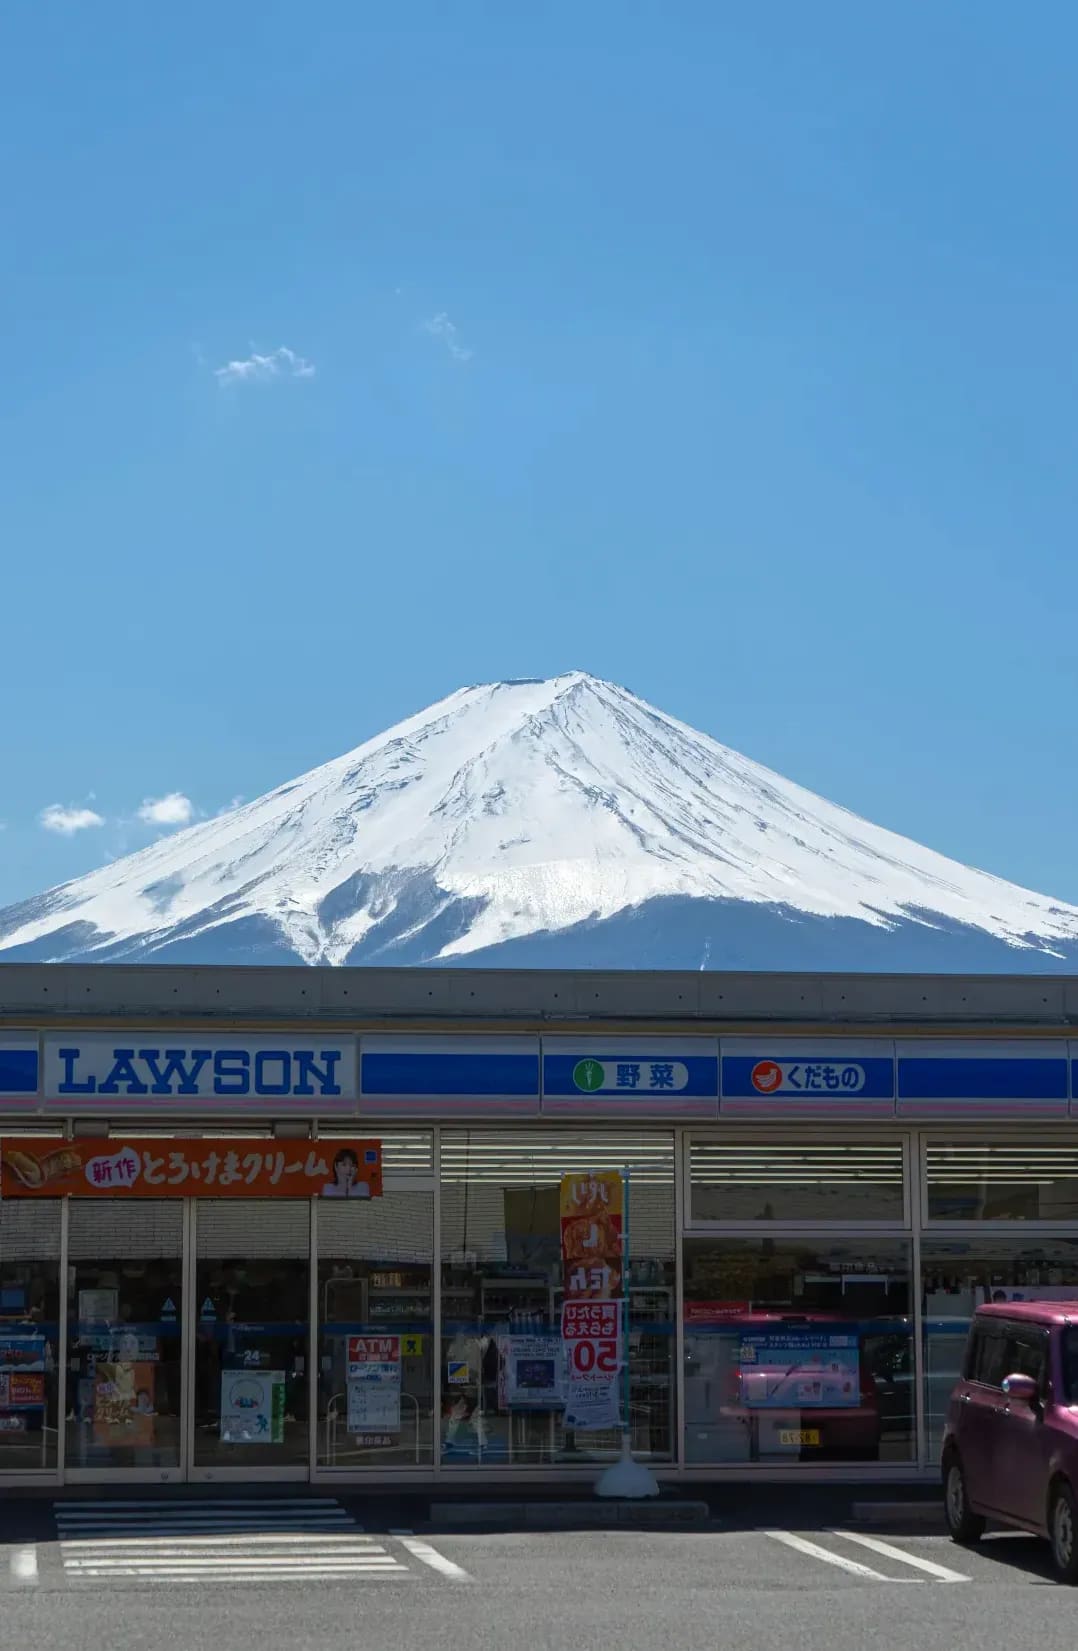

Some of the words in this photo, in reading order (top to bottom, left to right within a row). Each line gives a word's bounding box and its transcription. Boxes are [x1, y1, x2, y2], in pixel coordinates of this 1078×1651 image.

[58, 1048, 341, 1095] LAWSON
[616, 1064, 674, 1088] 野菜
[787, 1066, 859, 1089] くだもの
[92, 1155, 137, 1183] 新作
[244, 1350, 261, 1361] 24
[355, 1339, 392, 1352] ATM
